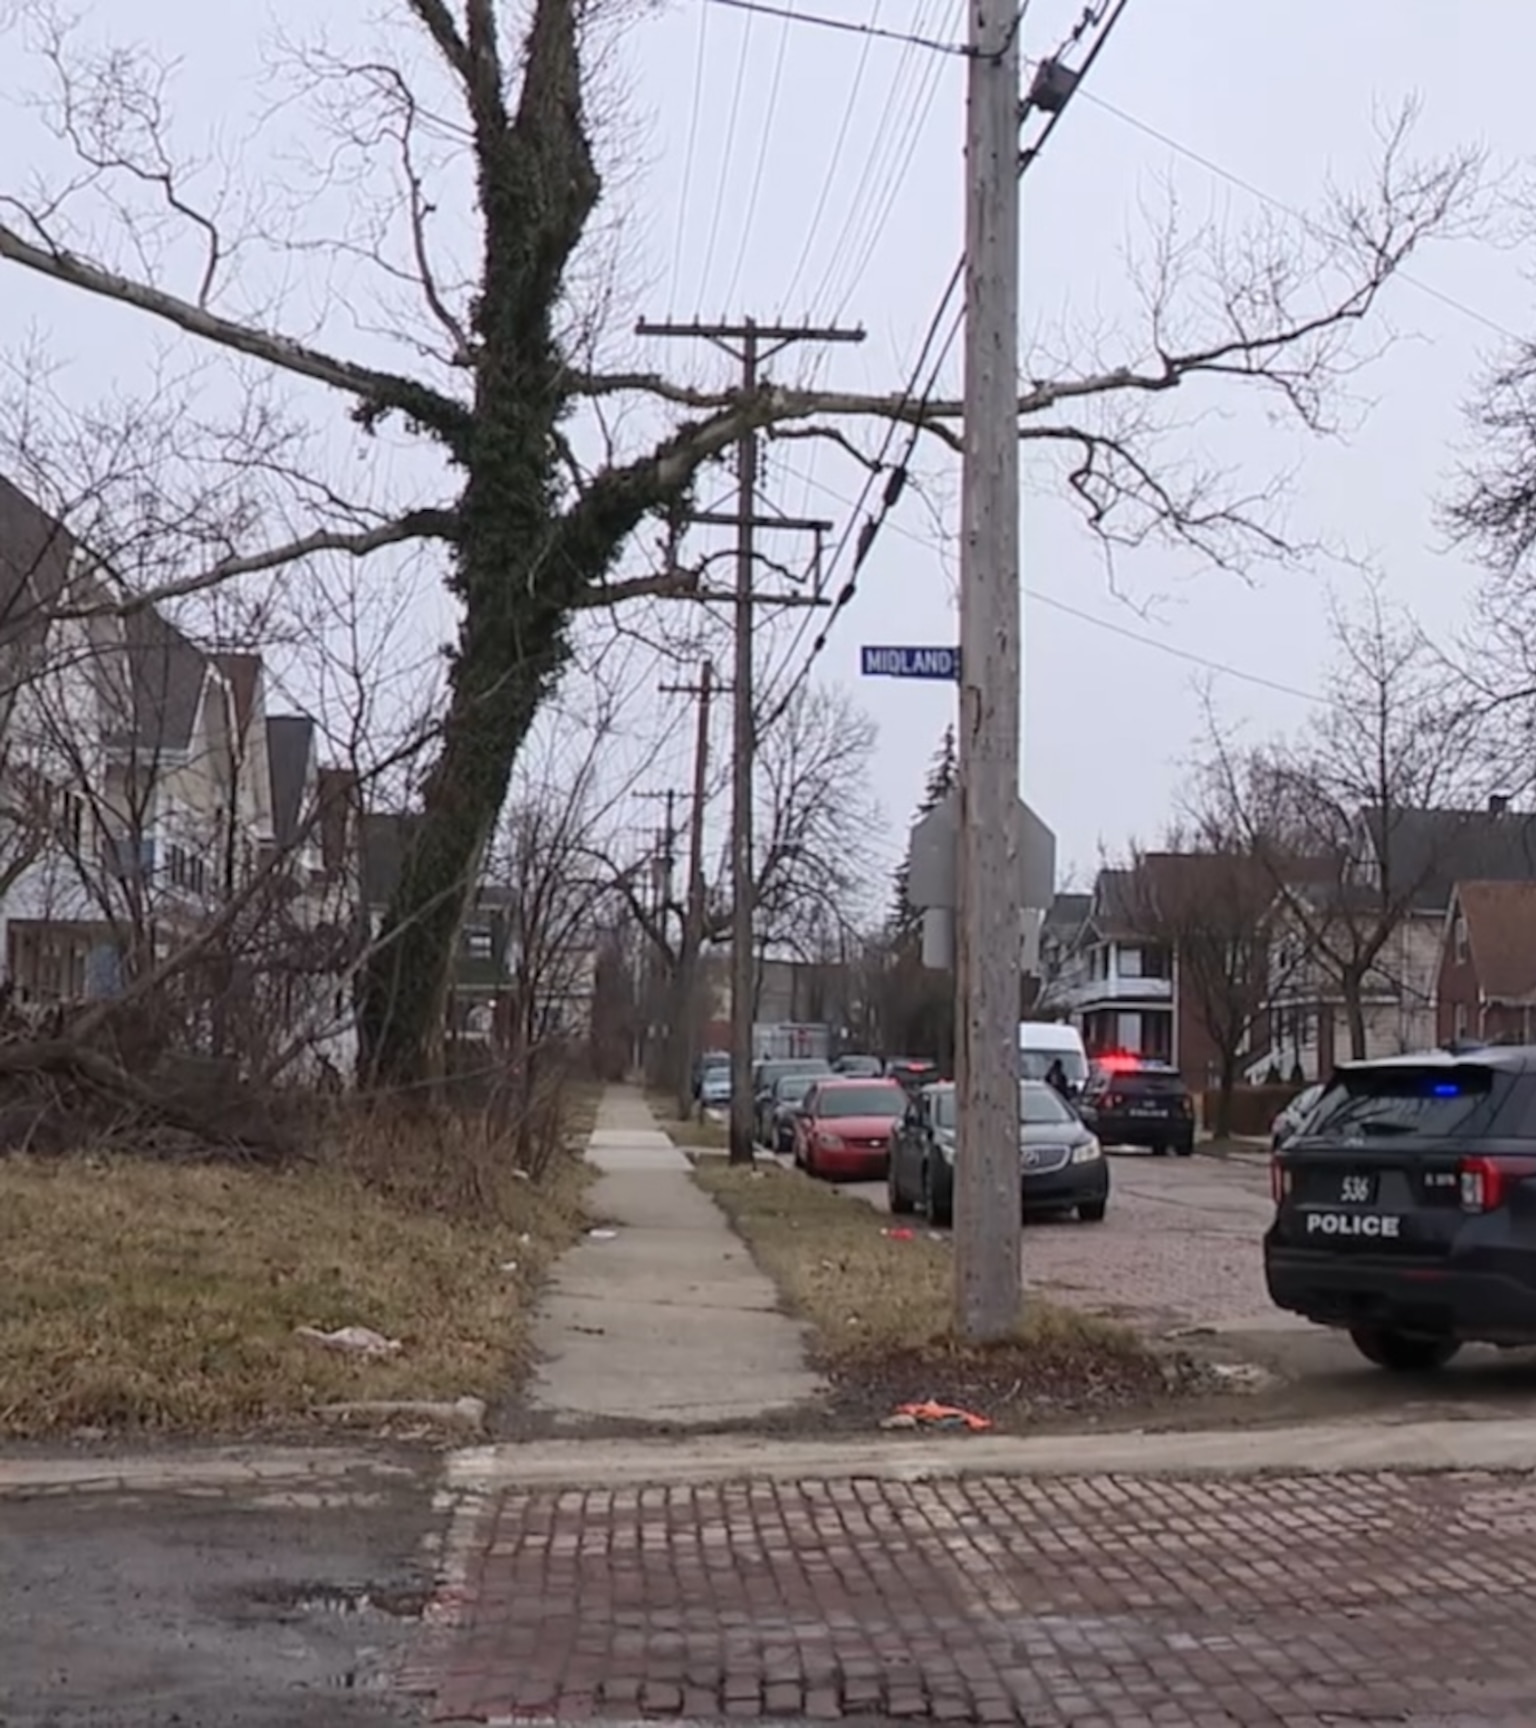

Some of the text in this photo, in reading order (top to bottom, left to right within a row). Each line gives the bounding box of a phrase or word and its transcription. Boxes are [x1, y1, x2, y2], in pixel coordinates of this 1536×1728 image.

[866, 649, 952, 674] MIDLAND
[1341, 1176, 1369, 1202] 536
[1307, 1213, 1400, 1237] POLICE
